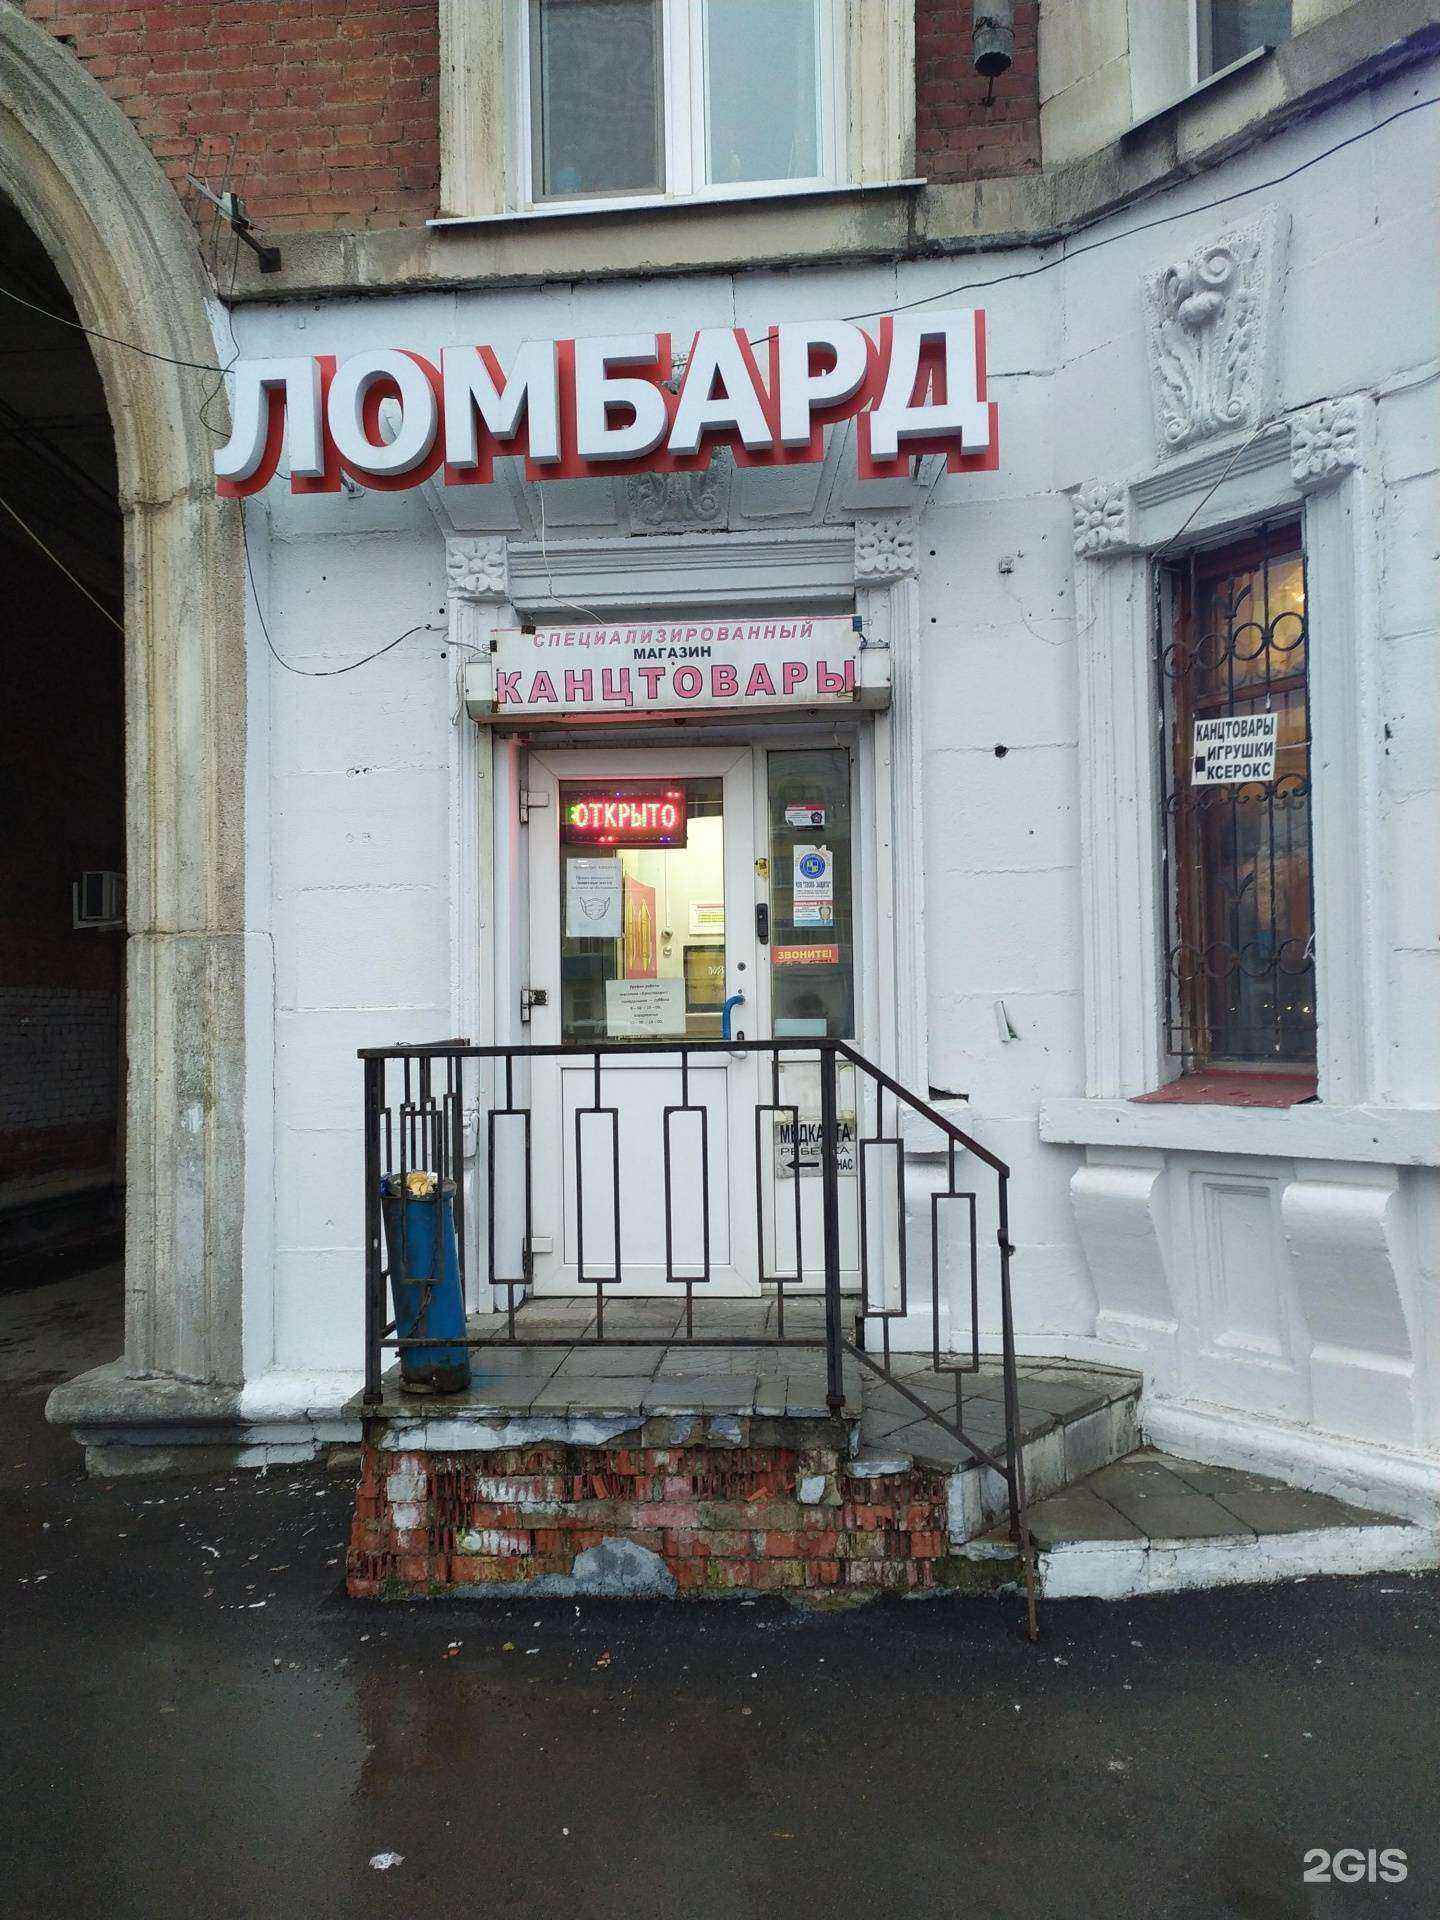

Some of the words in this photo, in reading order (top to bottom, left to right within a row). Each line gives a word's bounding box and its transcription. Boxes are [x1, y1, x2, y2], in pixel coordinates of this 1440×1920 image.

[214, 309, 998, 495] ЛОМБАРД
[532, 620, 815, 648] СПЕЦИАЛИЗИРОВАННЫЙ
[633, 645, 712, 660] МАГАЗИН
[496, 659, 856, 707] КАНЦТОВАРЫ
[1196, 717, 1274, 742] КАНЦТОВАРЫ
[1207, 742, 1273, 761] ИГРУШКИ
[1207, 762, 1271, 780] КСЕРОКС
[576, 802, 675, 828] ОТКРЫТО
[780, 1123, 851, 1145] МДКАТА
